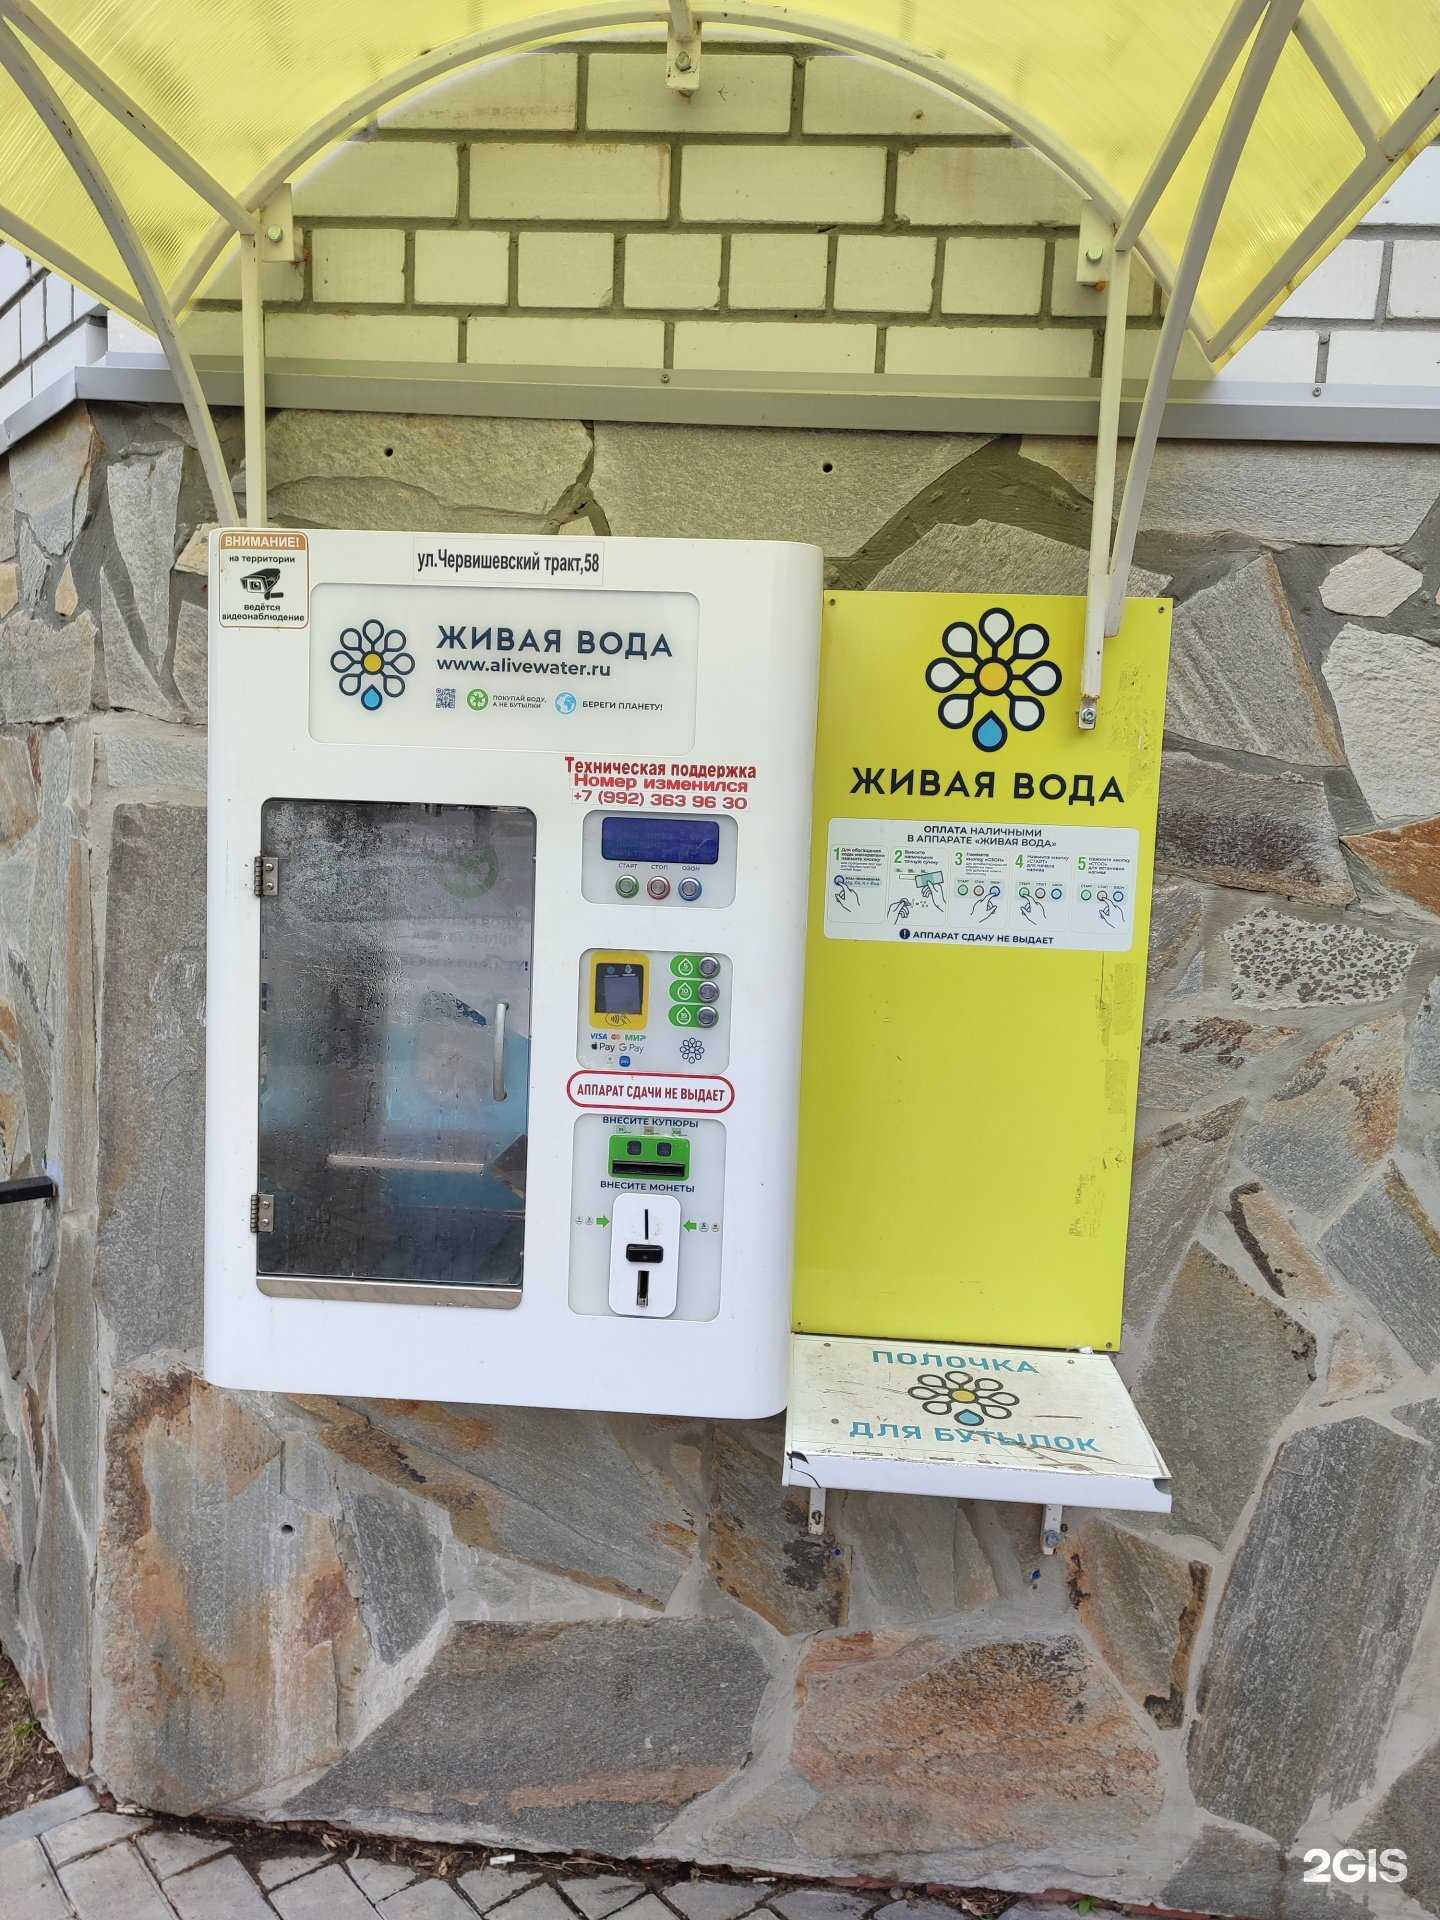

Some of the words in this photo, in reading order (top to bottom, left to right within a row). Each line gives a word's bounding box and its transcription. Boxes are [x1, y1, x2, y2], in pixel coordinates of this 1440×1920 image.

[225, 536, 299, 548] ВНИМАНИЕ!
[242, 556, 295, 564] территории
[418, 549, 540, 572] ул.Червишевский
[544, 552, 599, 575] тракт,58
[244, 602, 280, 611] ведётся
[222, 612, 304, 622] видеонаблюдение
[436, 625, 561, 653] ЖИВАЯ
[577, 630, 672, 660] ВОДА
[437, 658, 610, 677] www.alivewater.ru
[582, 701, 616, 709] БЕРЕГИ
[619, 702, 662, 711] ПЛАНЕТУ!
[565, 756, 665, 776] Техническая
[671, 763, 756, 780] поддержка
[574, 774, 637, 791] Номер
[644, 778, 748, 793] изменился
[850, 767, 995, 798] ЖИВАЯ
[1013, 772, 1125, 806] ВОДА
[574, 790, 592, 803] +7
[598, 791, 644, 806] (992)
[651, 794, 686, 808] 363
[692, 795, 716, 809] 96
[722, 797, 747, 810] 30
[924, 825, 967, 835] ОПЛАТА
[971, 827, 1042, 837] НАЛИЧНЫМИ
[907, 835, 914, 843] В
[916, 835, 972, 845] АППАРАТЕ
[975, 837, 1018, 846] «ЖИВАЯ
[1021, 838, 1056, 848] ВОДА»
[834, 847, 840, 861] 1
[894, 850, 902, 864] 2
[955, 852, 963, 866] 3
[1015, 854, 1024, 868] 4
[1078, 856, 1086, 870] 5
[913, 931, 959, 941] АППАРАТ
[961, 933, 994, 943] СДАЧУ
[997, 934, 1010, 943] НЕ
[1013, 935, 1054, 945] ВЫДАЕТ
[591, 1033, 608, 1041] VISA
[625, 1034, 647, 1042] МИР
[599, 1043, 615, 1053] Pay
[629, 1044, 644, 1055] Pay
[577, 1085, 624, 1097] АППАРАТ
[627, 1086, 661, 1100] СДАЧИ
[664, 1087, 677, 1099] НЕ
[681, 1088, 725, 1102] ВЫДАЕТ
[602, 1116, 649, 1126] ВНЕСИТЕ
[652, 1118, 698, 1128] КУПЮРЫ
[600, 1181, 646, 1191] ВНЕСИТЕ
[650, 1184, 695, 1193] МОНЕТЫ
[872, 1350, 1039, 1375] ПОЛОЧКА
[849, 1421, 921, 1440] ДЛЯ
[935, 1426, 1102, 1453] БУТЫЛОК
